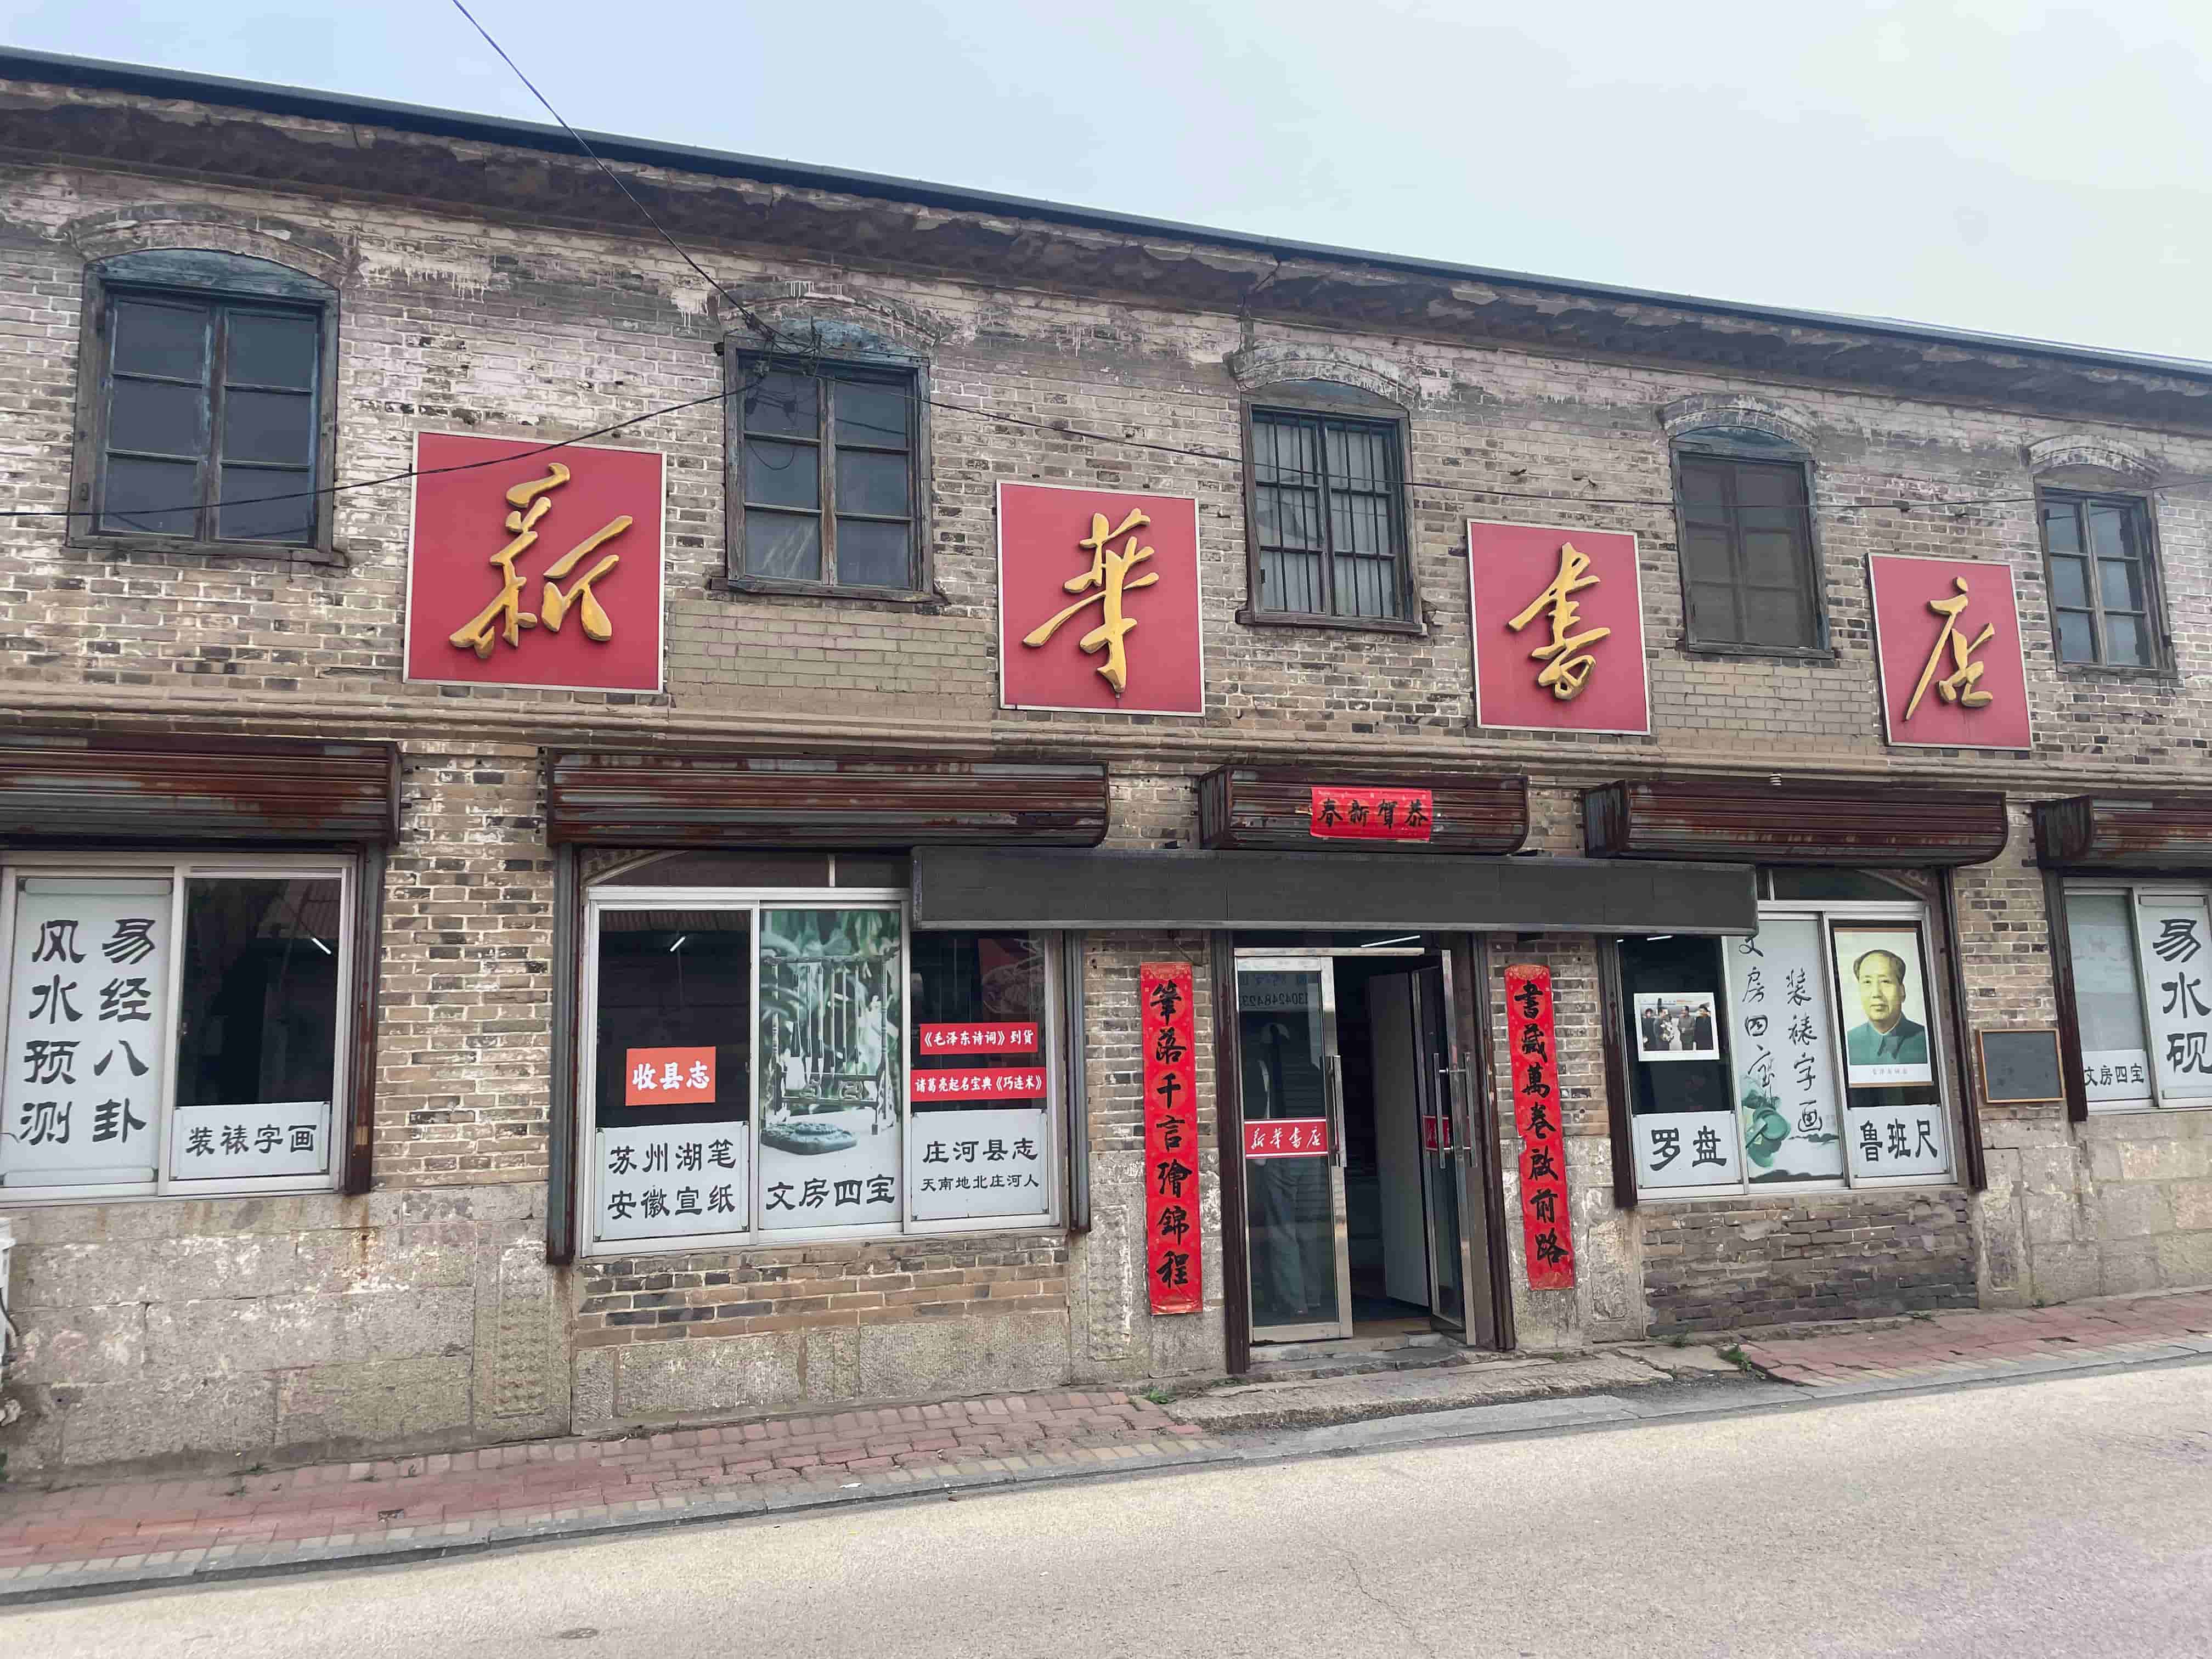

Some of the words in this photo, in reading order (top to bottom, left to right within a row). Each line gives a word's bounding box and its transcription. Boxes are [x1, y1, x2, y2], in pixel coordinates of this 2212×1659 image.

[2153, 918, 2212, 1074] 易水砚
[19, 919, 87, 1146] 风水预测
[92, 918, 156, 1143] 易经八卦
[632, 1061, 710, 1090] 收县志
[2084, 1063, 2145, 1086] 文房四宝
[185, 1124, 318, 1156] 装裱字画
[608, 1139, 736, 1175] 苏州湖笔
[922, 1137, 1039, 1164] 庄河县志
[1650, 1125, 1727, 1171] 罗盘
[1860, 1119, 1938, 1162] 鲁班尺
[766, 1175, 895, 1210] 文房四宝
[921, 1174, 1039, 1192] 天南地北庄河人
[607, 1184, 736, 1220] 安徽宣纸
